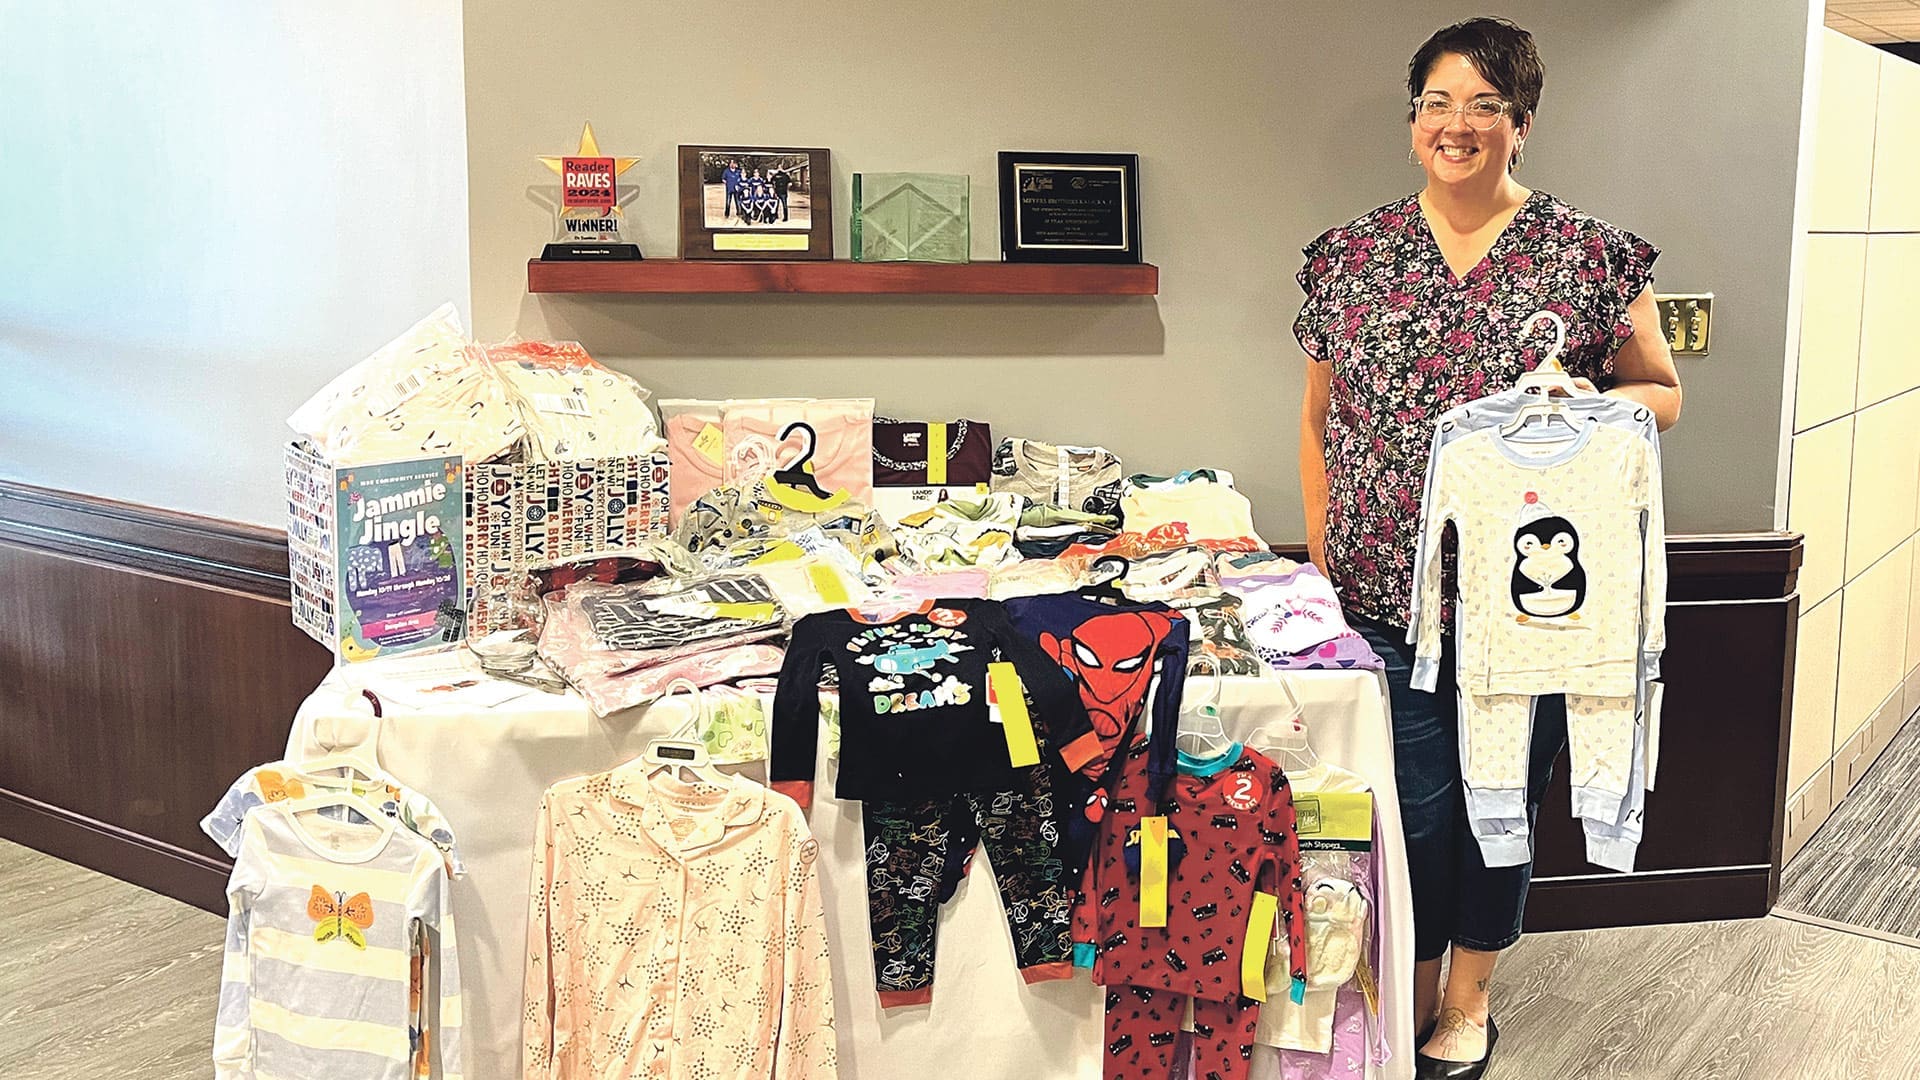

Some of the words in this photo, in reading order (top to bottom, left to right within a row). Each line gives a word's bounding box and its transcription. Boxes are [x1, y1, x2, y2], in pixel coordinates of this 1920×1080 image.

[566, 161, 609, 172] Reader
[566, 173, 611, 188] RAVES
[566, 219, 618, 232] WINNER!
[375, 474, 413, 485] COMMUNITY
[536, 464, 545, 480] LET
[536, 484, 545, 494] IT
[353, 480, 446, 522] Jammie
[502, 511, 512, 528] OH
[562, 497, 573, 542] MERRY
[584, 504, 594, 520] OH
[640, 490, 650, 533] MERRY
[359, 511, 441, 546] Jingle
[477, 503, 489, 550] MERRY
[873, 685, 971, 715] DREAMS
[1233, 778, 1252, 801] 2
